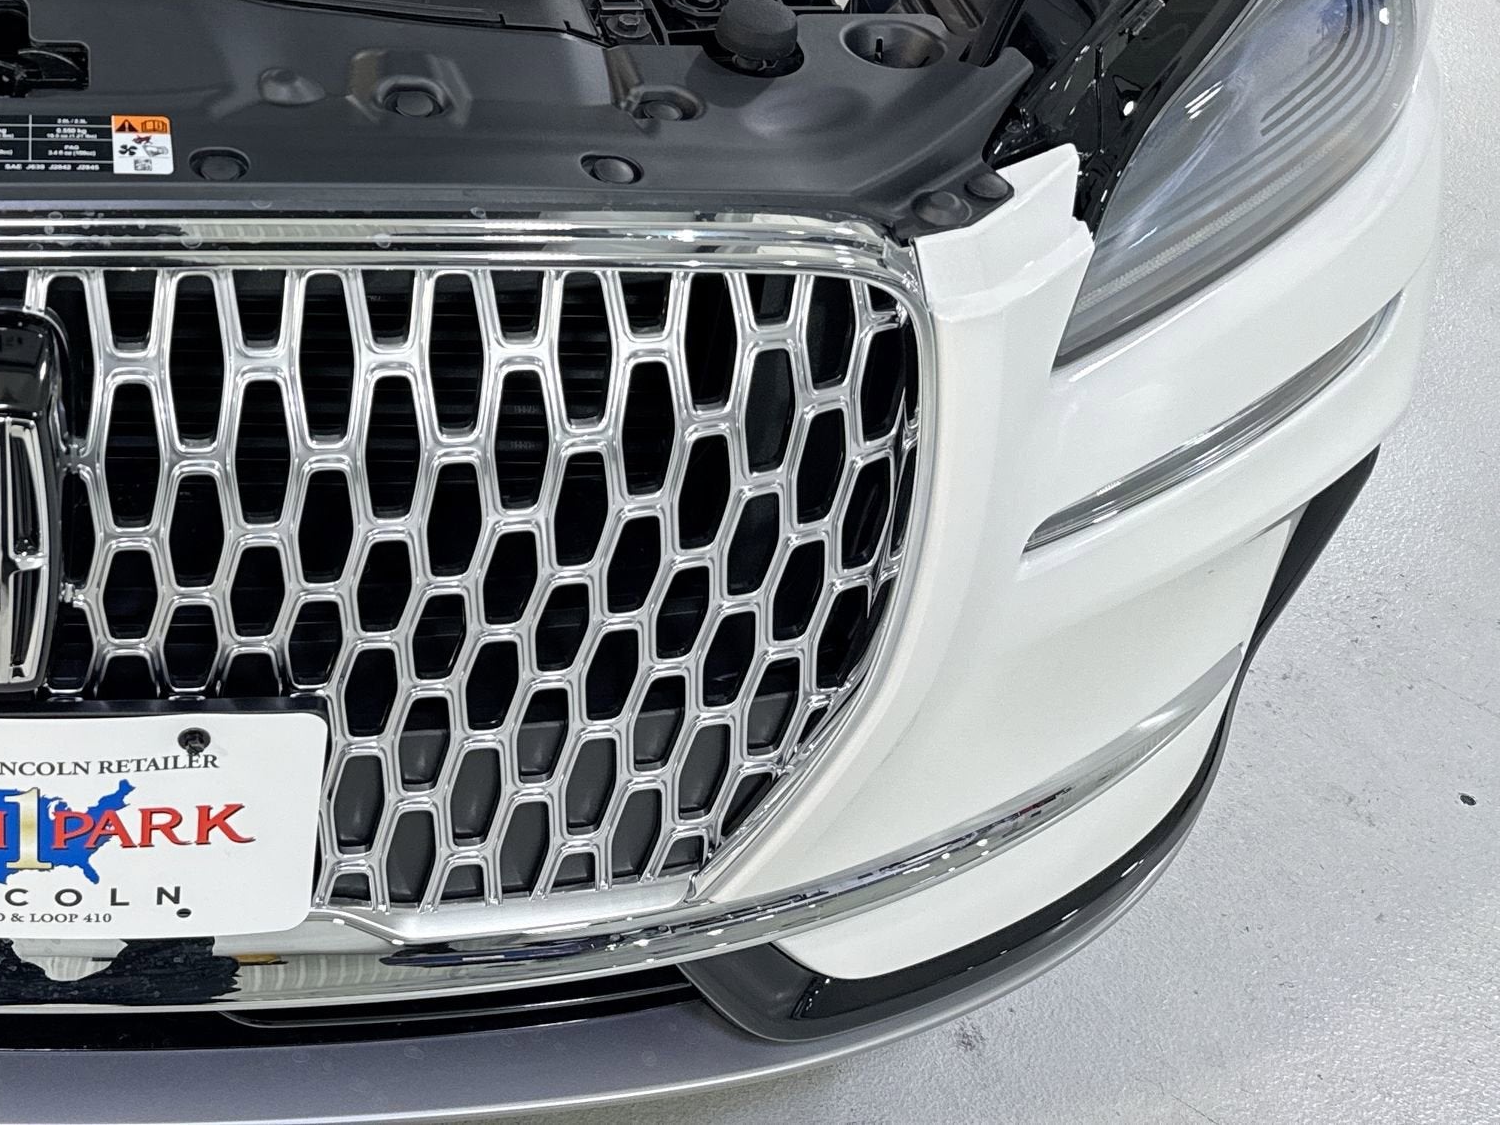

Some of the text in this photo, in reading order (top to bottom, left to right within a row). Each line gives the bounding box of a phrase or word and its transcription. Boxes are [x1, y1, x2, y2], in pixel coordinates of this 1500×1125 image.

[98, 753, 220, 775] RETAILER
[52, 803, 256, 851] PARK
[10, 912, 24, 923] &
[30, 912, 79, 923] LOOP
[83, 912, 112, 923] 410
